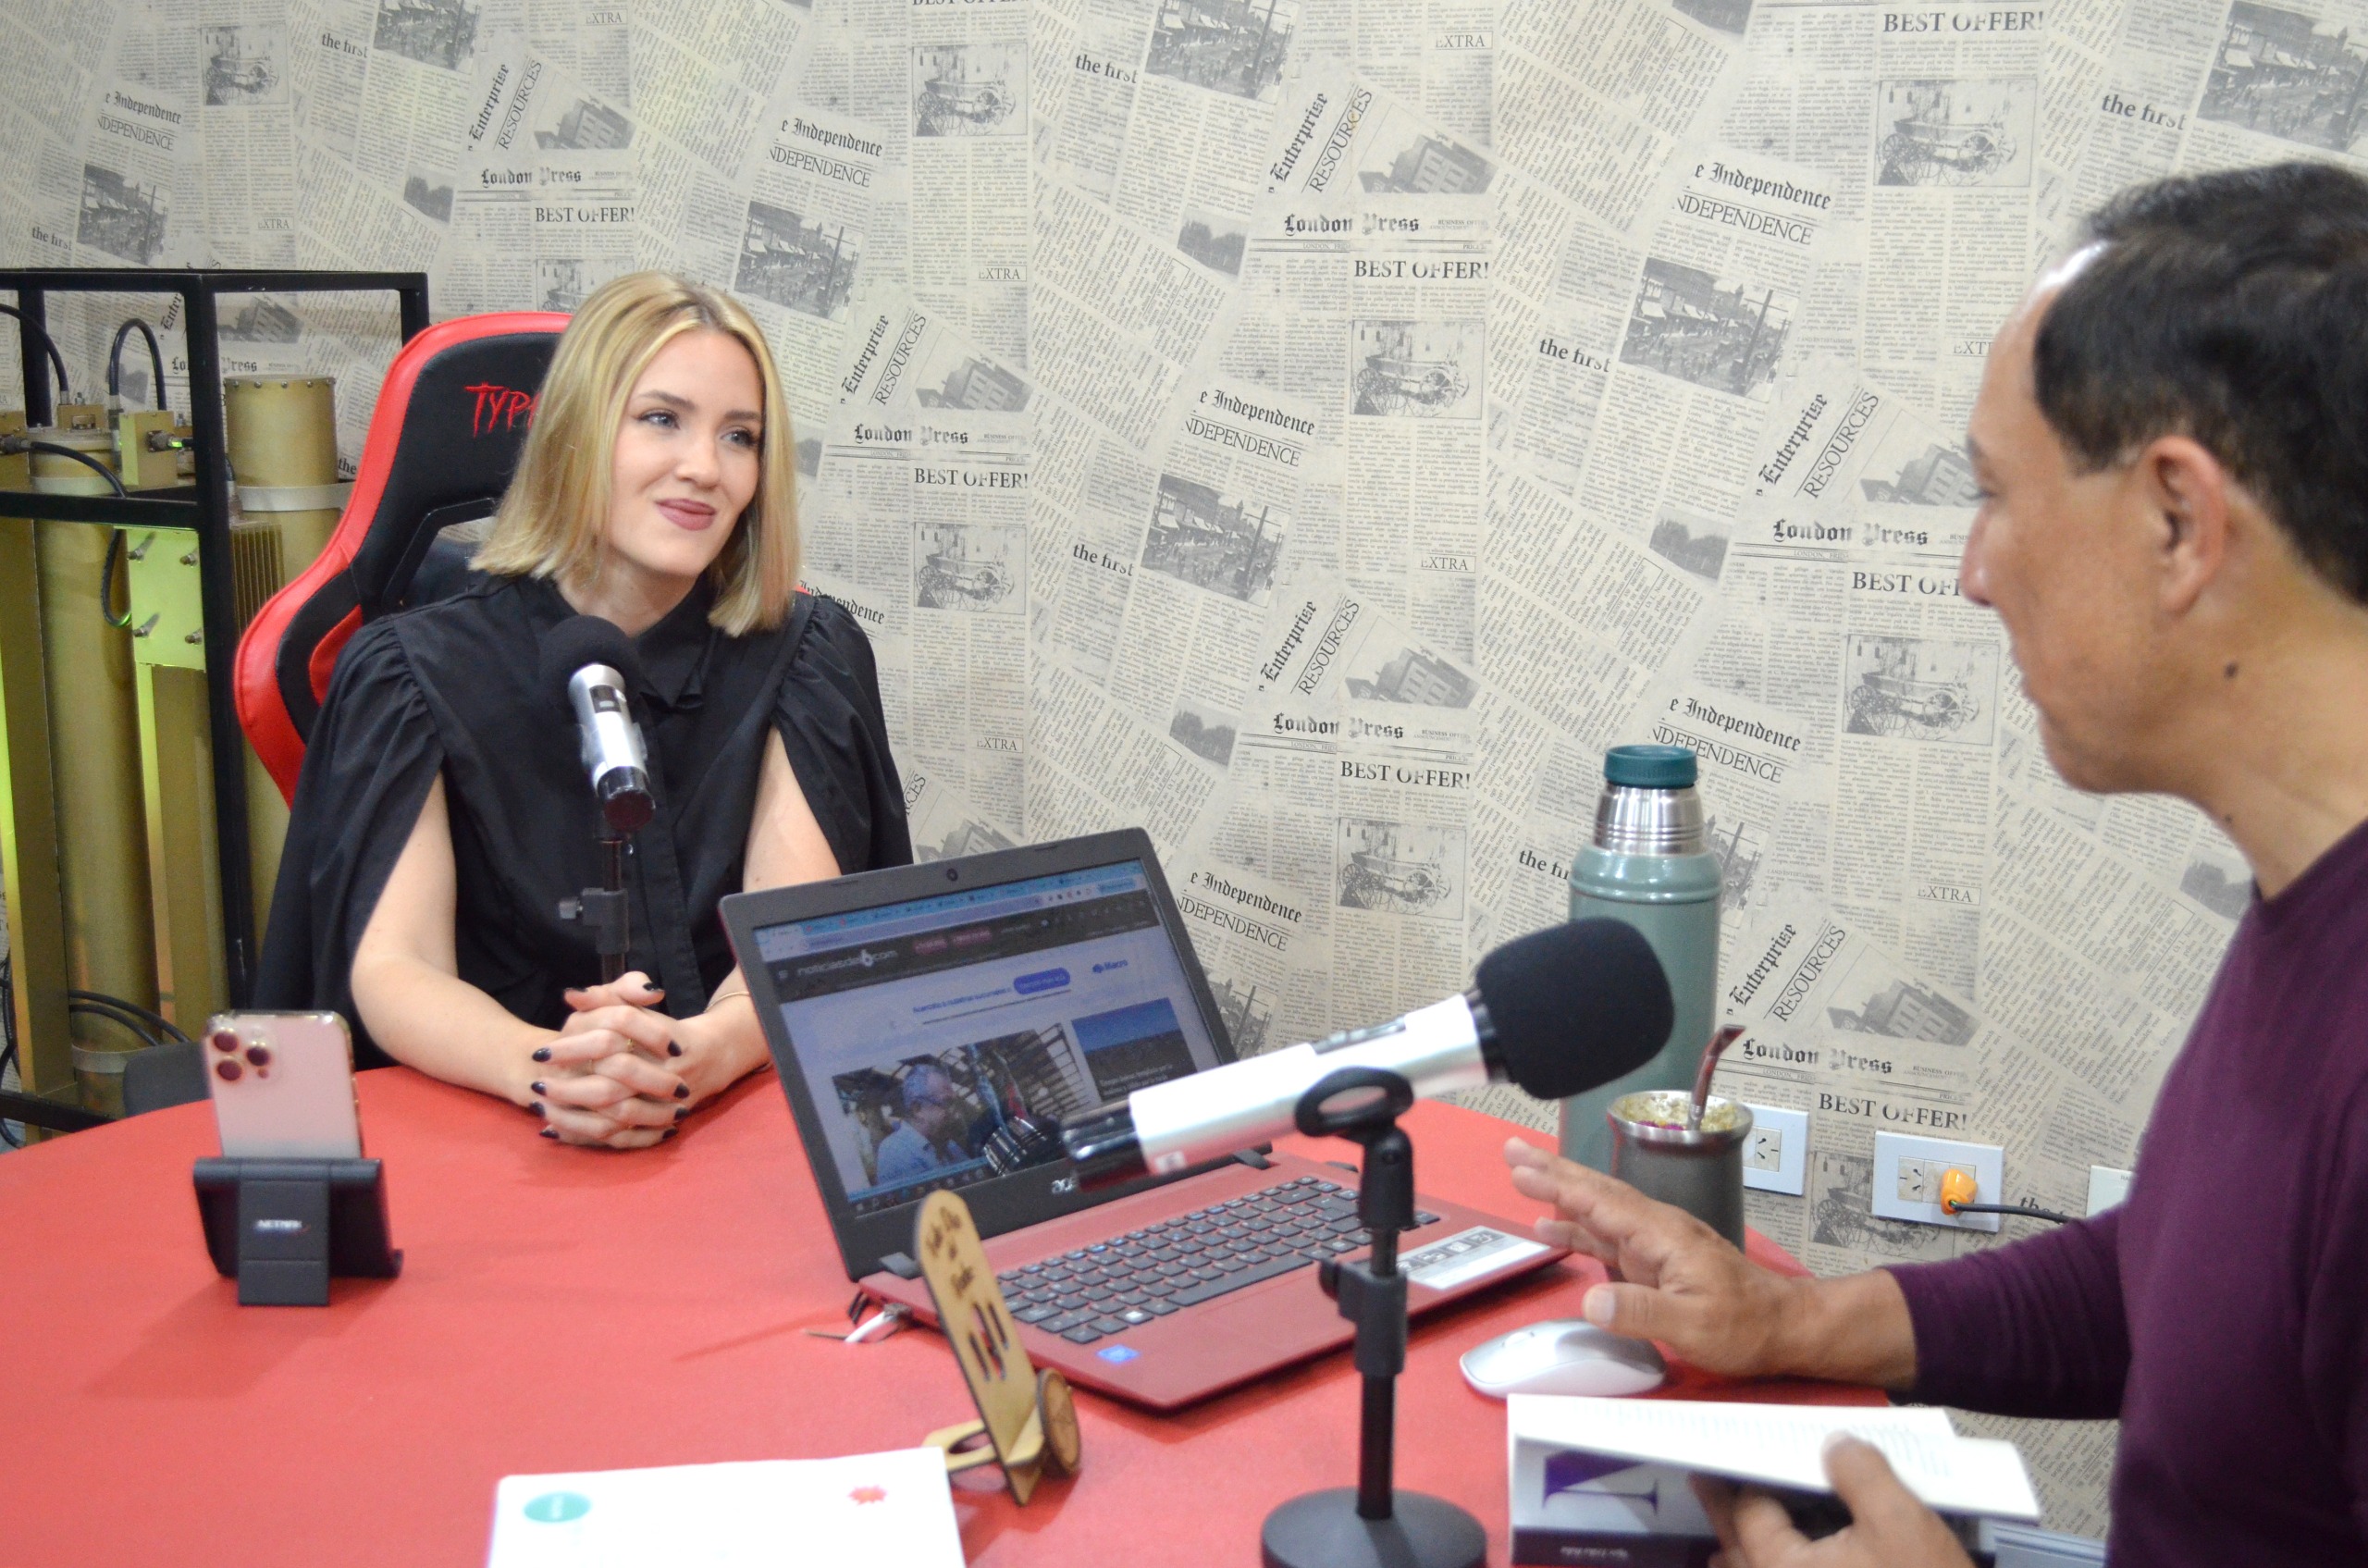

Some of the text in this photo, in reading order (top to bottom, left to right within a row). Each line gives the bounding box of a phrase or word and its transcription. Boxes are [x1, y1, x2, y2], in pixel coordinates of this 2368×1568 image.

[1884, 11, 2043, 32] BEST OFFER!
[321, 33, 341, 51] the
[1076, 54, 1101, 74] the
[114, 91, 182, 125] Independence
[499, 60, 542, 150] RESOURCES
[2102, 93, 2136, 117] the
[793, 117, 882, 157] Independence
[1270, 93, 1327, 182] Enterprise
[1309, 90, 1372, 193] RESOURCES
[482, 168, 533, 189] London
[1709, 162, 1831, 210] Independence
[536, 207, 635, 223] BEST OFFER!
[1284, 213, 1353, 237] London
[31, 226, 49, 242] the
[1354, 259, 1489, 279] BEST OFFER!
[841, 315, 888, 394] Enterprise
[874, 314, 926, 405] RESOURCES
[1538, 338, 1611, 373] the first
[1212, 389, 1315, 437] Independence
[854, 423, 912, 445] London
[1758, 392, 1828, 486] Enterprise
[1802, 391, 1879, 500] RESOURCES
[914, 468, 1029, 488] BEST OFFER!
[1773, 517, 1853, 543] London
[1072, 543, 1098, 563] the
[1852, 571, 1912, 593] BEST
[1261, 601, 1317, 683] Enterprise
[1298, 599, 1361, 696] RESOURCES
[1273, 711, 1339, 735] London
[1683, 698, 1801, 751] Independence
[1340, 759, 1471, 790] BEST OFFER!
[1519, 850, 1548, 871] the
[1202, 871, 1302, 923] Independence
[1729, 923, 1796, 1006] Enterprise
[1772, 925, 1846, 1022] RESOURCES
[1742, 1037, 1819, 1065] London
[1819, 1093, 1967, 1130] BEST OFFER!
